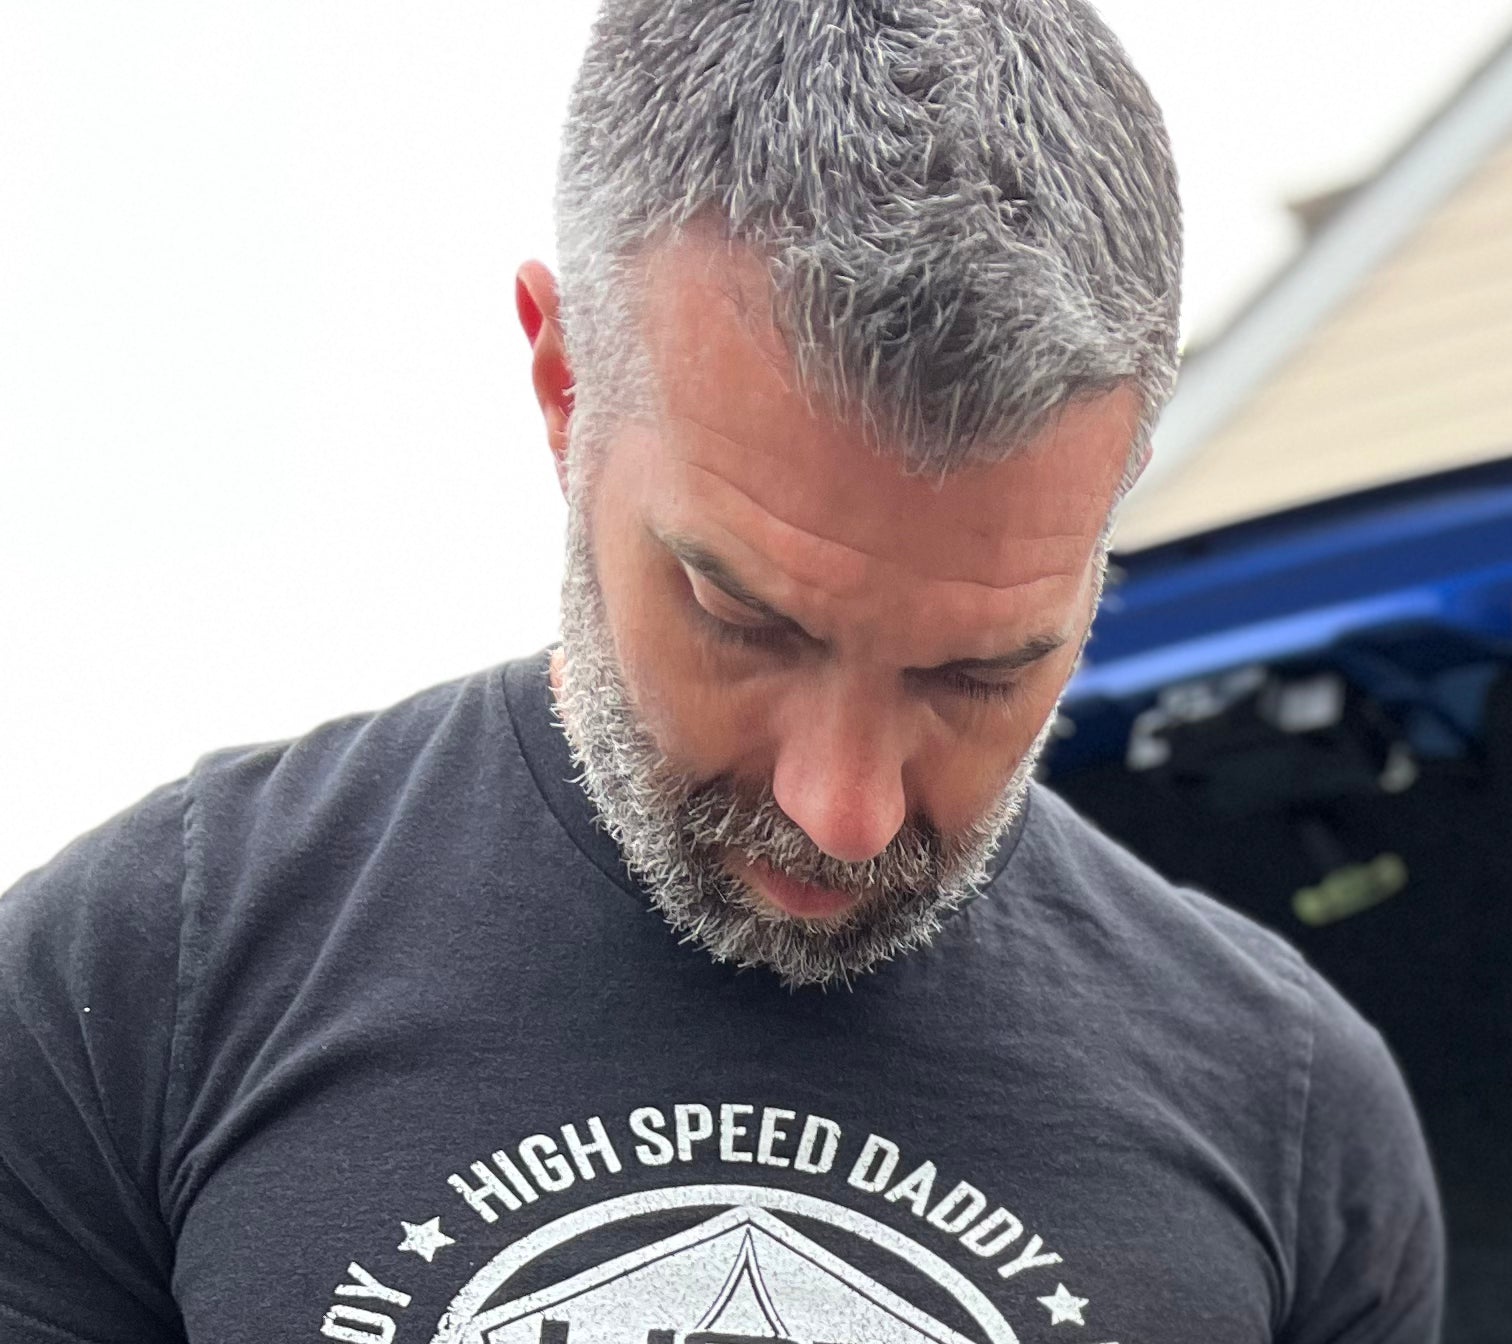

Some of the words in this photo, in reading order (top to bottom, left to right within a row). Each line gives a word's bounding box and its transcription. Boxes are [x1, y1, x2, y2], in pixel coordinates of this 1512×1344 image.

[447, 1117, 622, 1223] HIGH
[629, 1104, 841, 1174] SPEED
[848, 1134, 1063, 1278] DADDY
